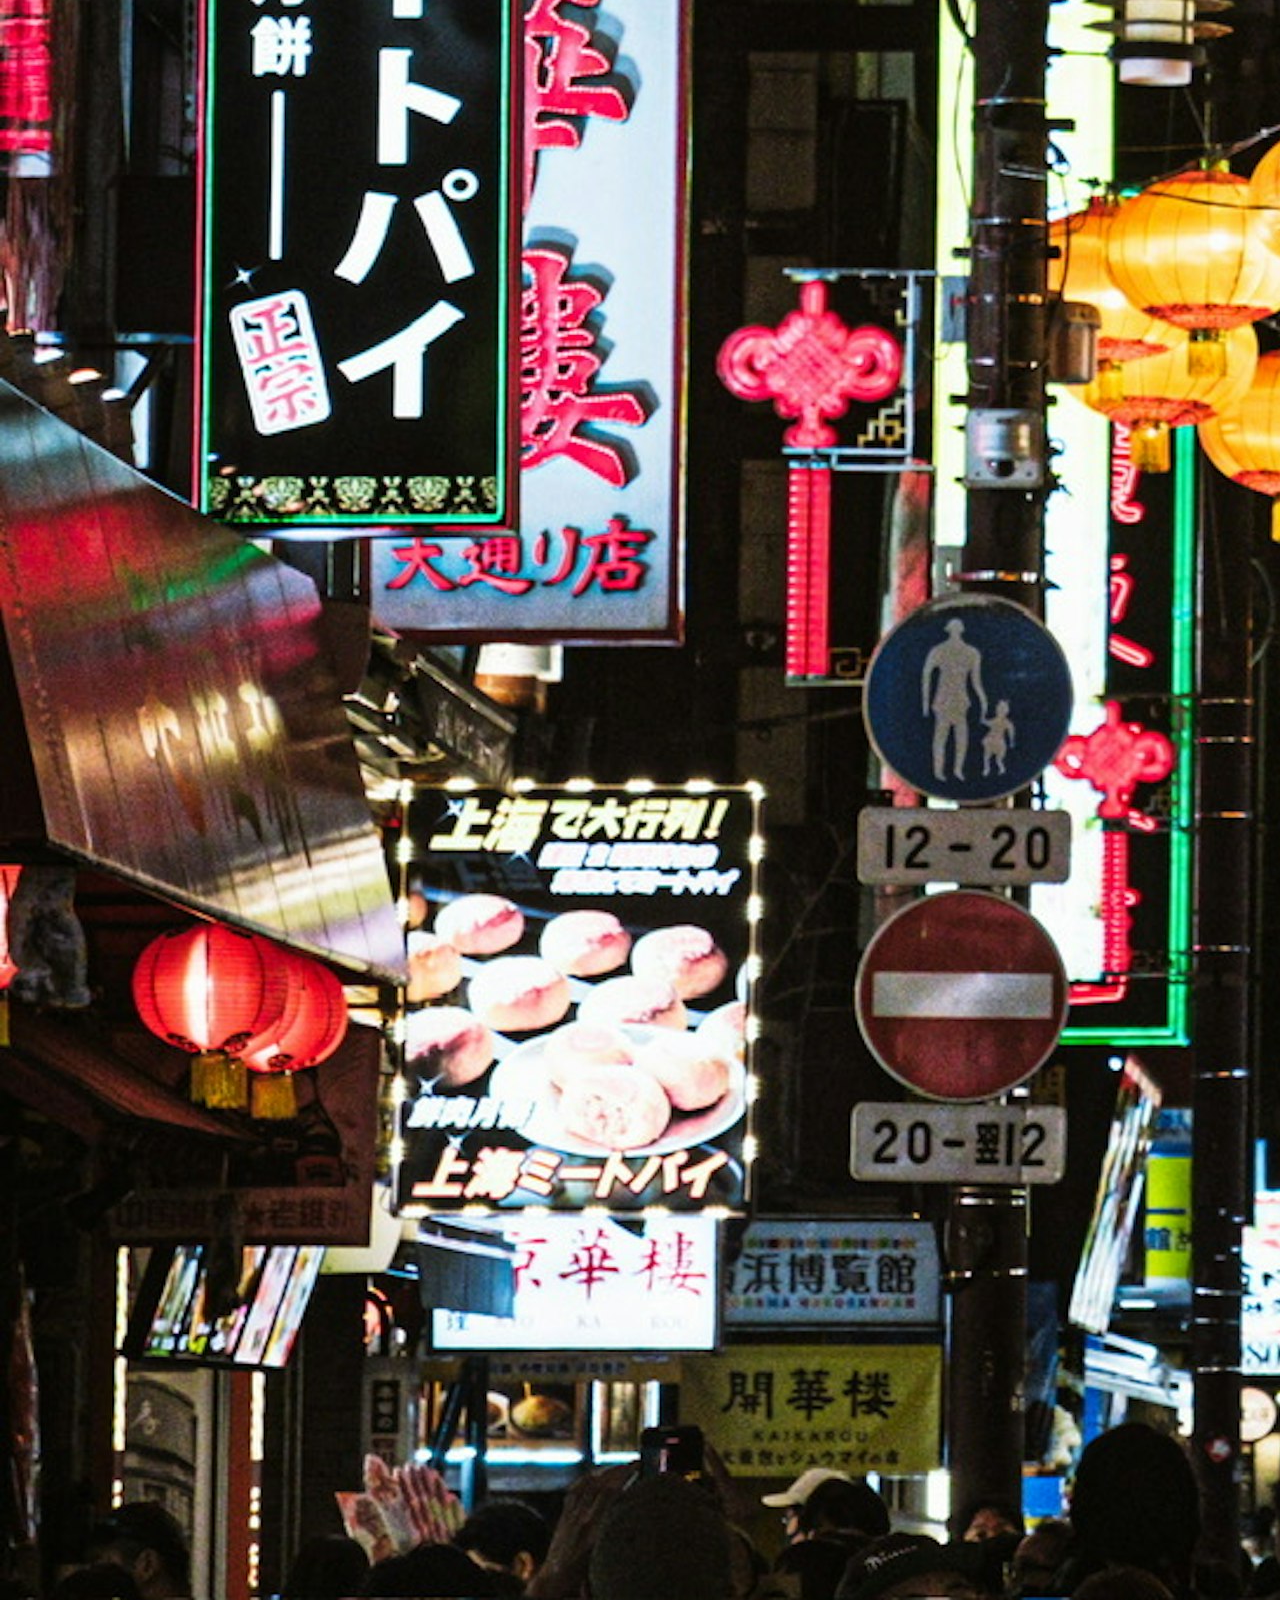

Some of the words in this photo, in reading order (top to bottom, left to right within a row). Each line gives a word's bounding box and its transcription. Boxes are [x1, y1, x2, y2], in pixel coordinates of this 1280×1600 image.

[242, 297, 320, 426] 正宗
[385, 517, 651, 598] 大通り店
